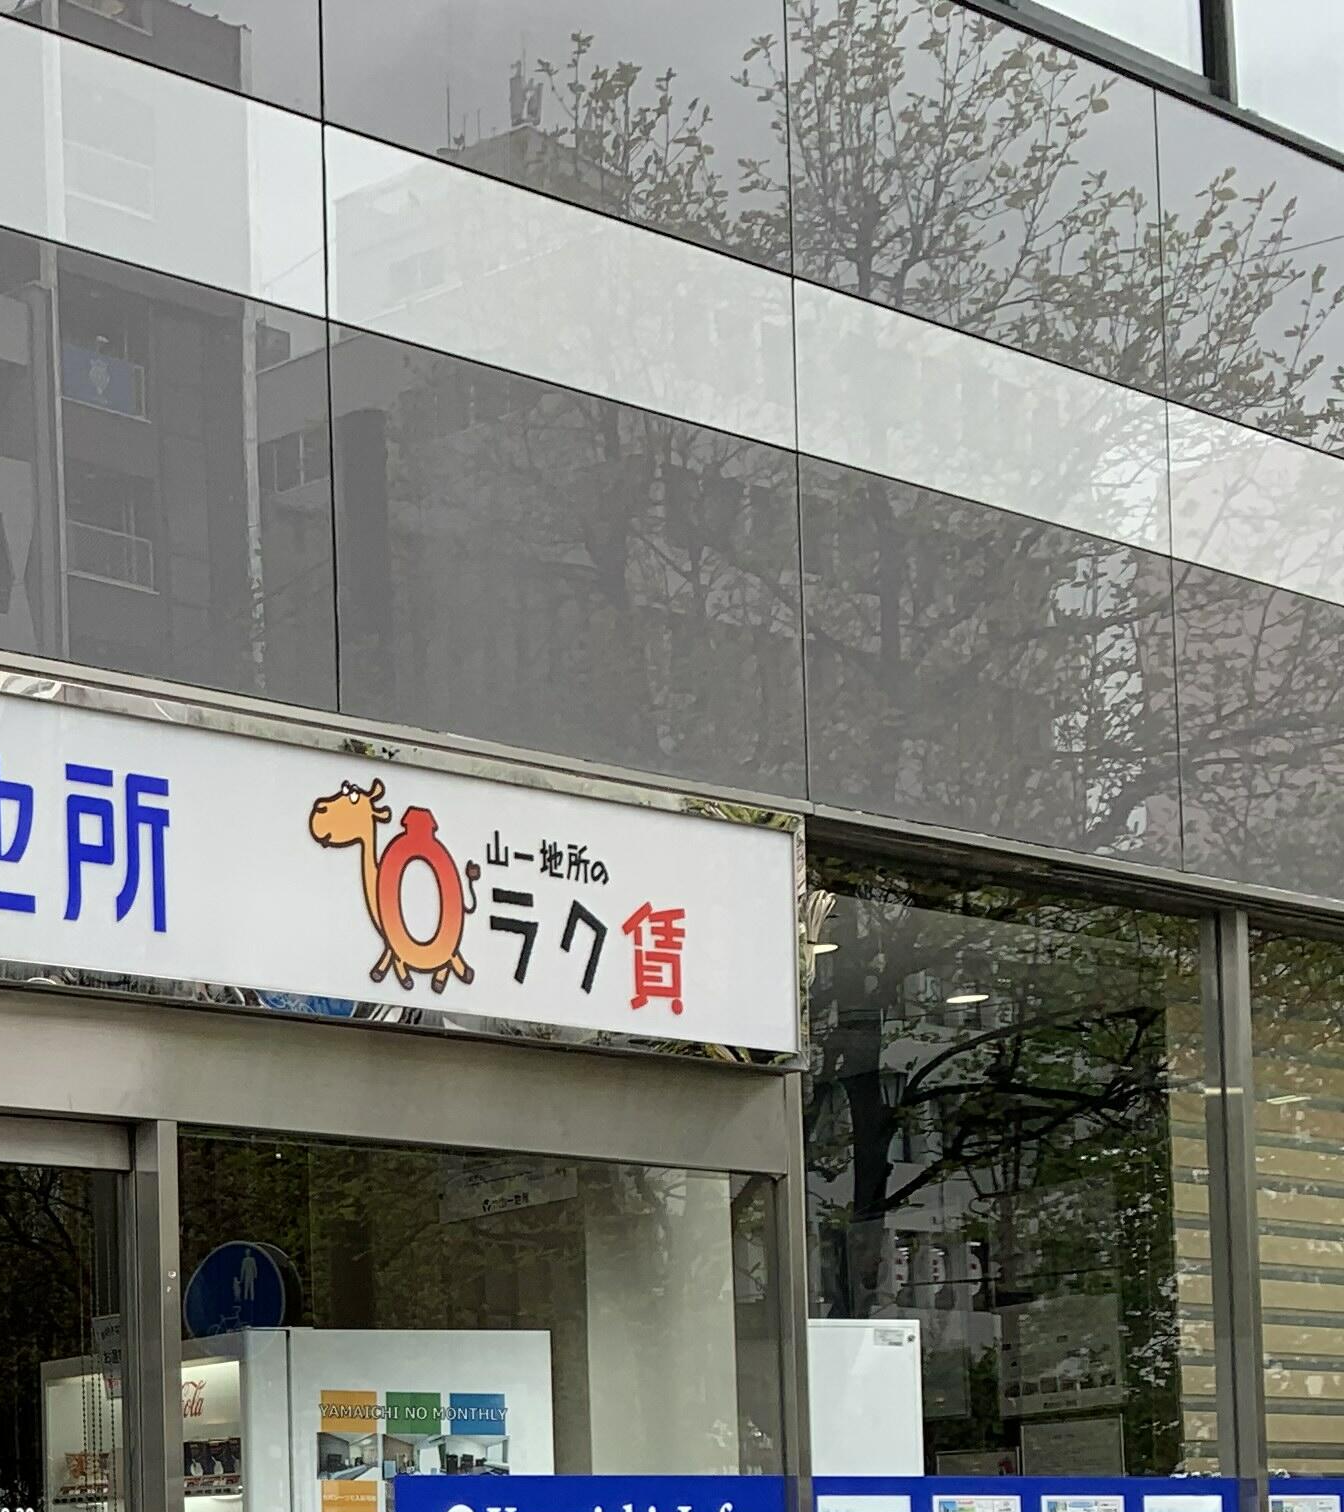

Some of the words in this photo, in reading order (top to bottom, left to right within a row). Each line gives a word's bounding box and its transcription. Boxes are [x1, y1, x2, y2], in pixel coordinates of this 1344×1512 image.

[486, 830, 609, 885] 山一地所の
[489, 887, 686, 1016] ラク賃
[318, 1402, 399, 1421] YAMAICHI
[404, 1404, 429, 1421] NO
[431, 1406, 508, 1422] MONTHLY
